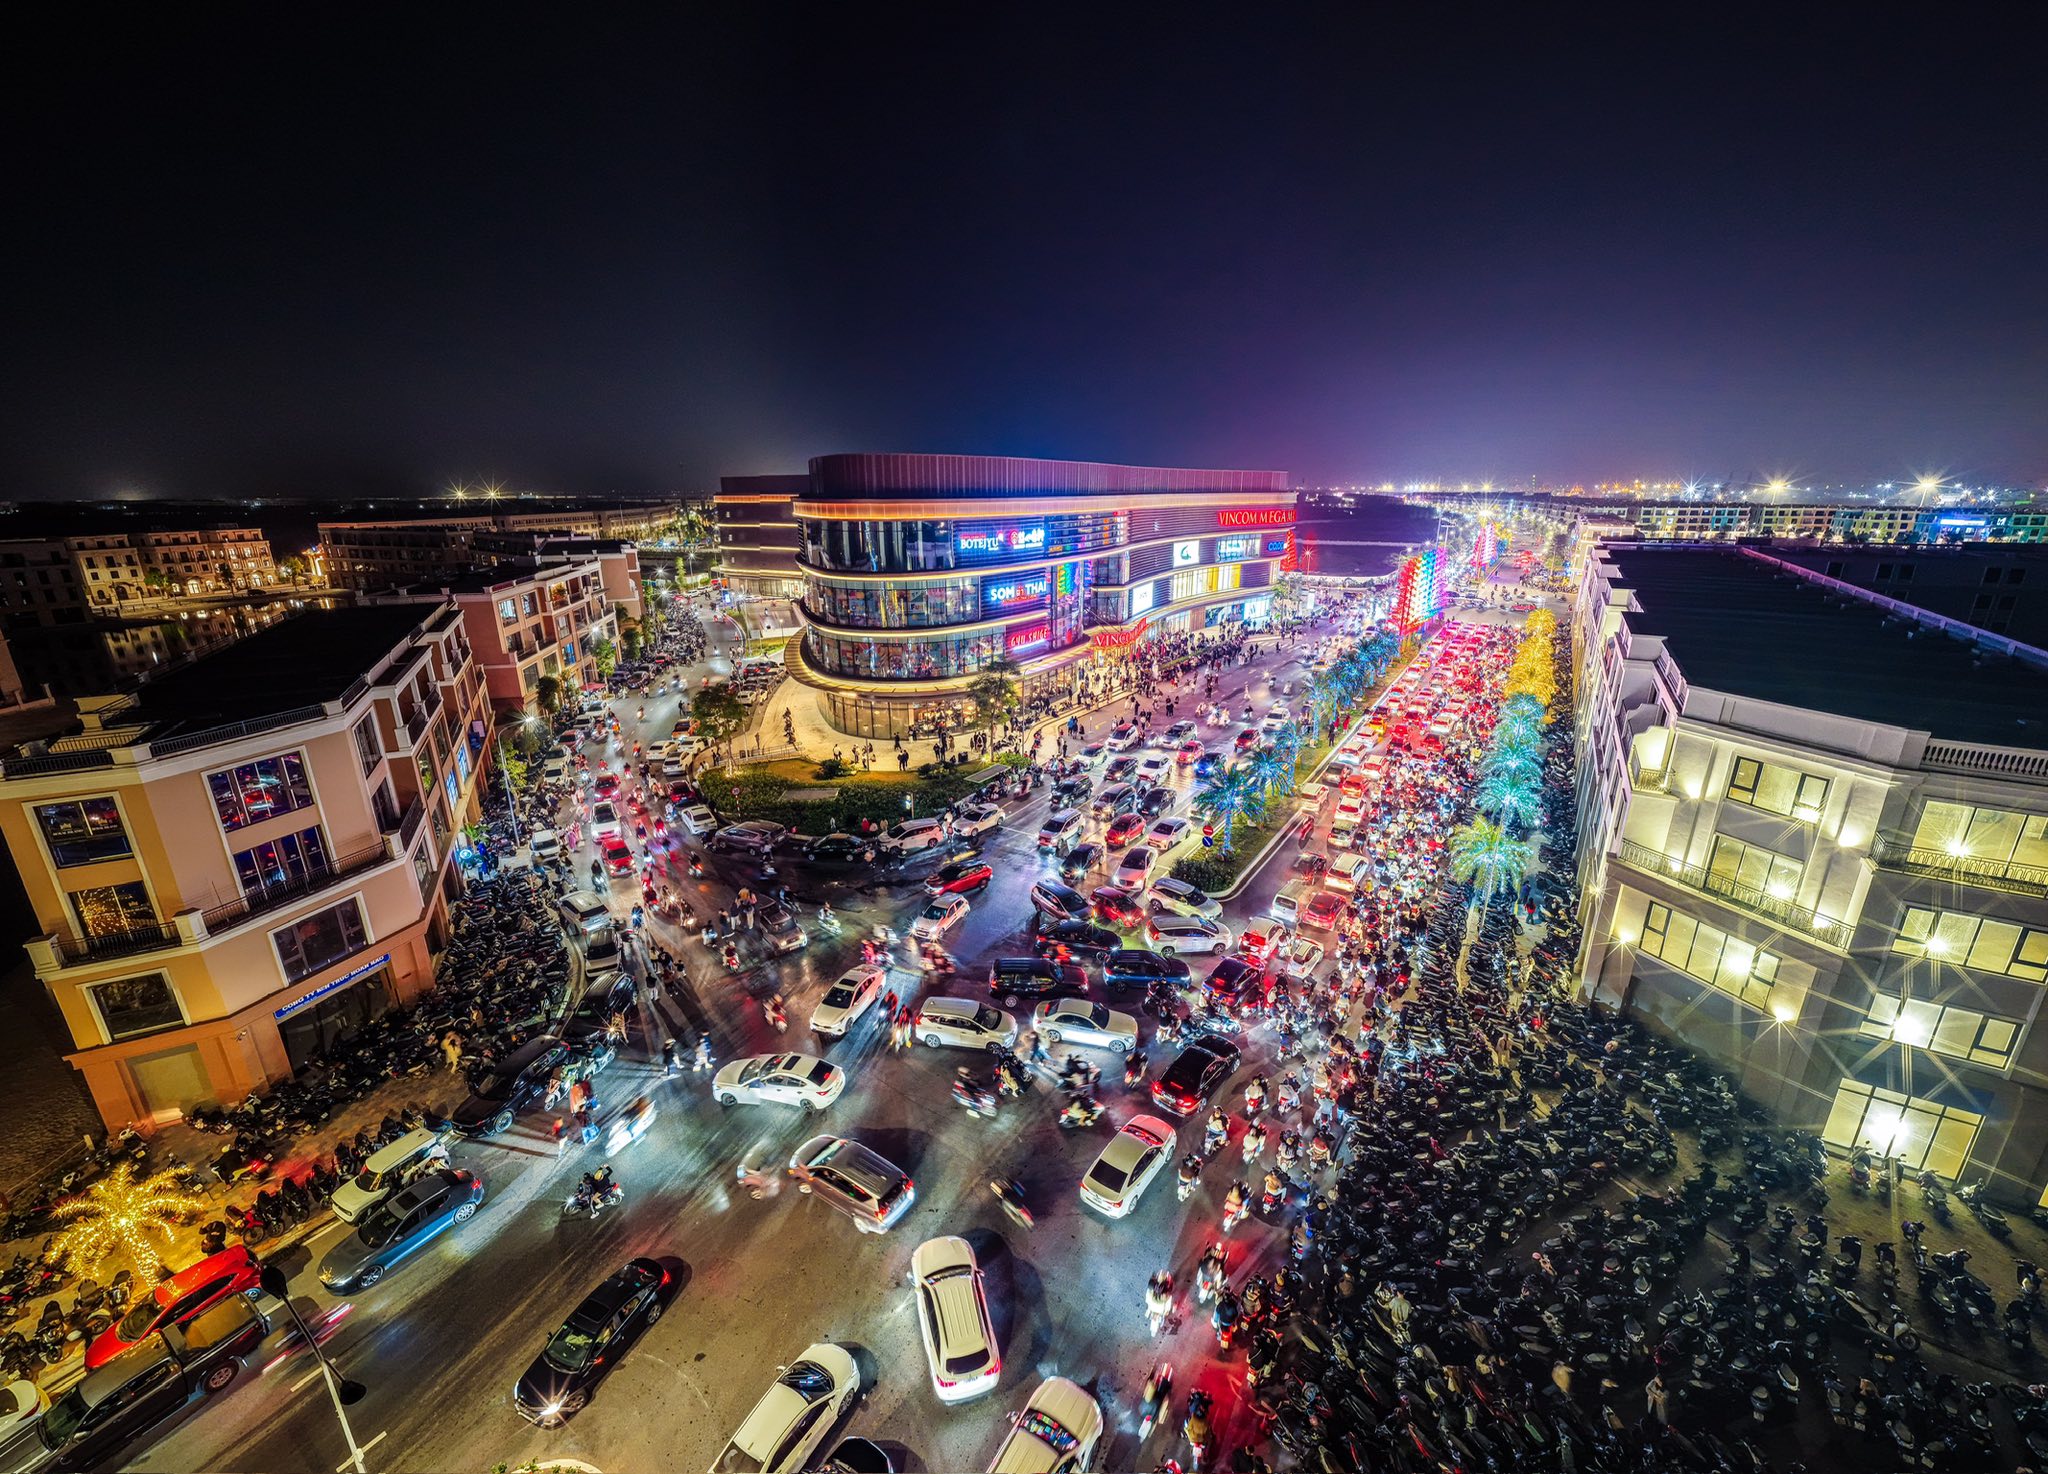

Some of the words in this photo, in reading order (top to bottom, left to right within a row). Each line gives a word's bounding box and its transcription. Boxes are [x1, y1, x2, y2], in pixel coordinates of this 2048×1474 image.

[1219, 511, 1257, 525] VINCOM
[1259, 511, 1286, 523] MEGA
[991, 586, 1015, 601] SOM
[1025, 581, 1047, 595] THAI
